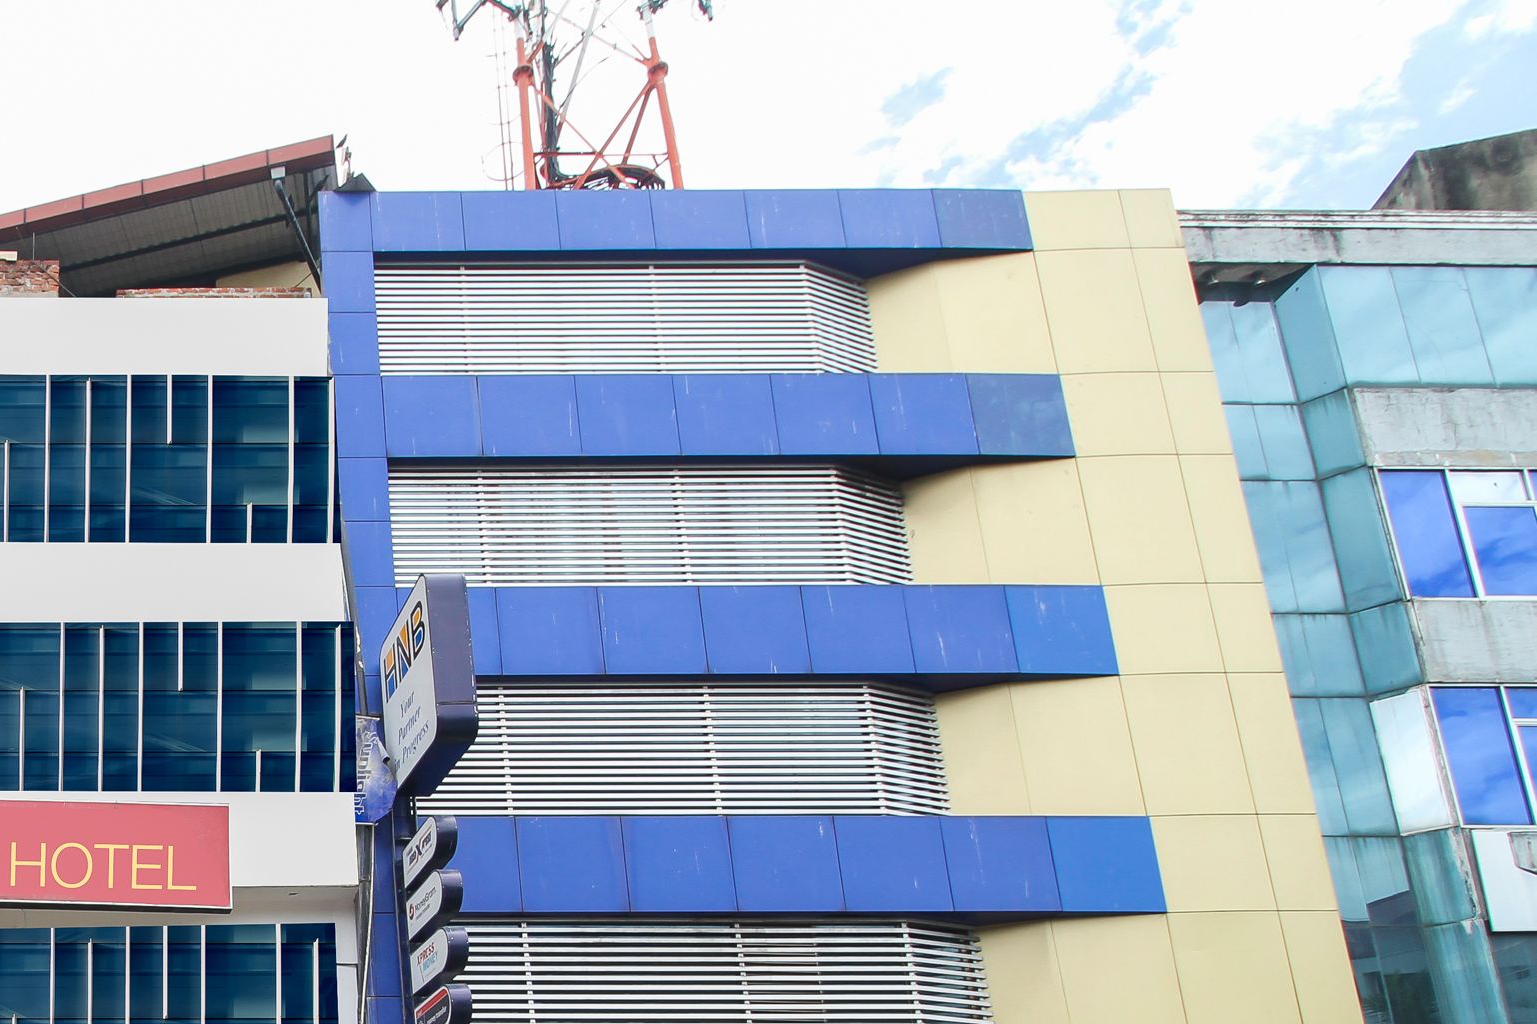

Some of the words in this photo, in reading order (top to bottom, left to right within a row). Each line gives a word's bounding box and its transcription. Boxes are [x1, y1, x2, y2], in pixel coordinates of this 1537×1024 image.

[383, 600, 426, 704] HNB
[398, 705, 421, 745] Partner
[400, 690, 415, 719] Your
[402, 718, 430, 765] Progress
[10, 841, 197, 891] HOTEL
